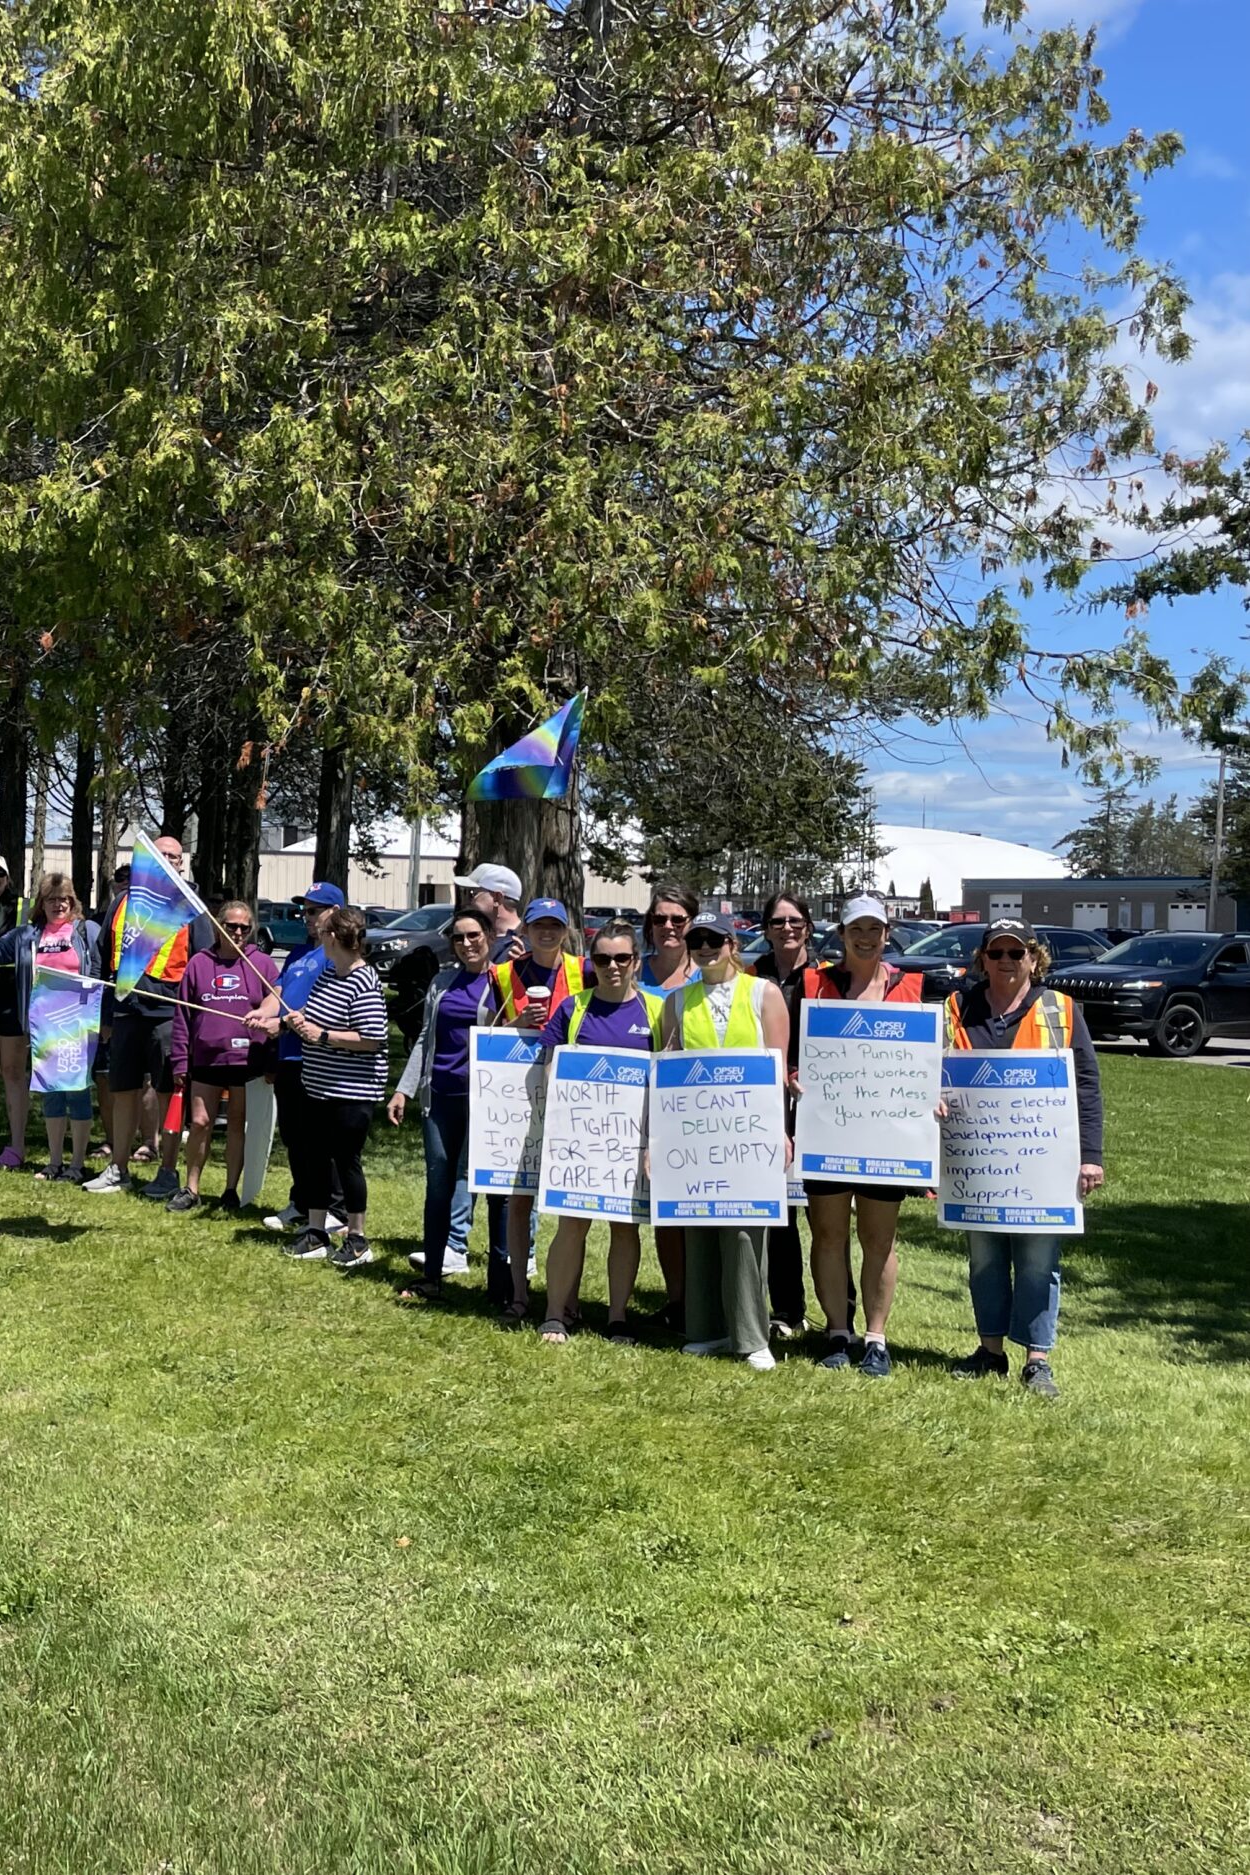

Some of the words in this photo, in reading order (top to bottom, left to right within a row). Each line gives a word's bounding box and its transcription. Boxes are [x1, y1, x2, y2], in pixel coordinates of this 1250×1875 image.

[874, 1020, 907, 1030] OPSEU
[873, 1029, 905, 1039] SEFPO
[857, 1043, 914, 1061] Punish
[617, 1066, 646, 1077] OPSEU
[713, 1066, 746, 1075] OPSEU
[807, 1063, 867, 1084] Support
[873, 1070, 928, 1080] workers
[1004, 1068, 1037, 1077] OPSEU
[617, 1075, 645, 1084] SEFPO
[713, 1074, 744, 1083] SEFPO
[1003, 1076, 1036, 1086] SEFPO
[556, 1082, 620, 1106] WORTH
[823, 1083, 841, 1101] for
[854, 1084, 881, 1099] the
[890, 1086, 927, 1100] Mess
[661, 1094, 688, 1113] WE
[977, 1099, 1001, 1109] our
[1010, 1096, 1068, 1109] elected
[871, 1106, 924, 1119] made
[1009, 1111, 1044, 1125] that
[682, 1114, 769, 1136] DELIVER
[941, 1126, 1058, 1144] Developmental
[548, 1139, 587, 1161] FOR
[666, 1147, 698, 1170] ON
[709, 1143, 778, 1167] EMPTY
[945, 1143, 1009, 1158] Services
[1017, 1146, 1049, 1157] are
[549, 1164, 601, 1189] CARE
[603, 1168, 618, 1192] 4
[686, 1180, 731, 1195] WFF
[951, 1180, 1034, 1204] Supports
